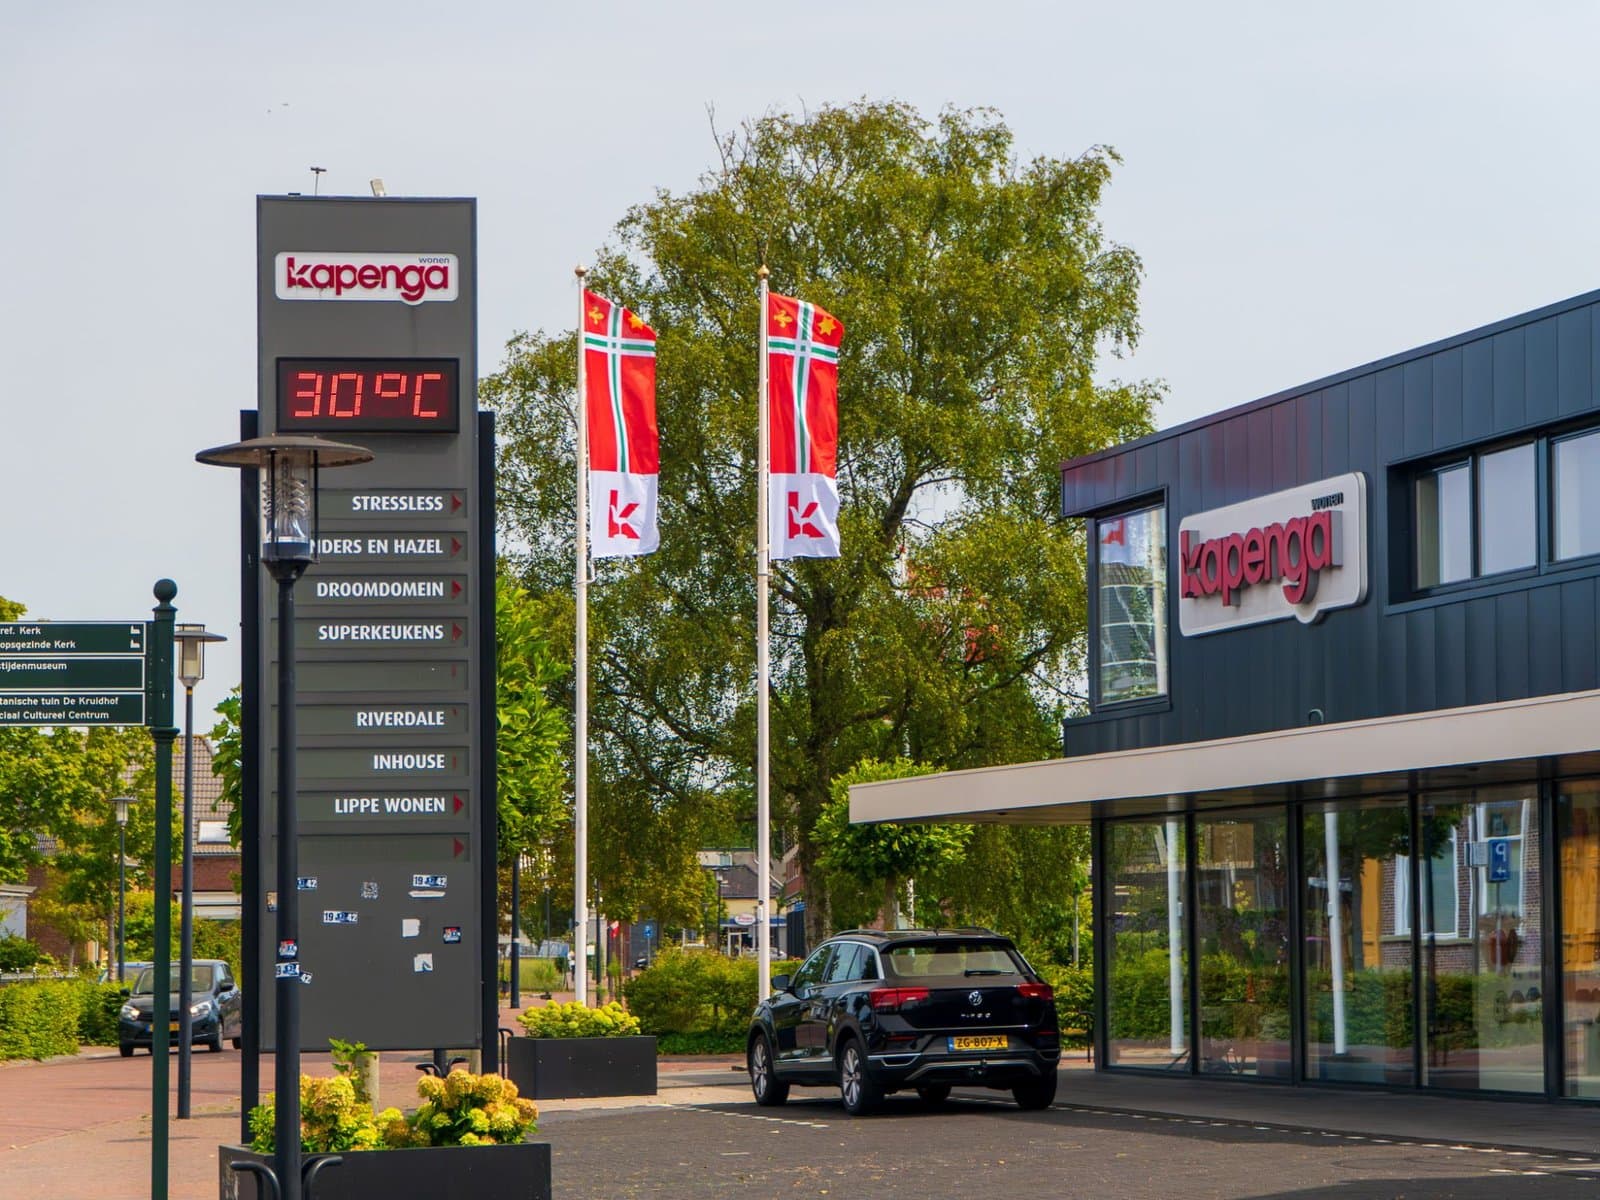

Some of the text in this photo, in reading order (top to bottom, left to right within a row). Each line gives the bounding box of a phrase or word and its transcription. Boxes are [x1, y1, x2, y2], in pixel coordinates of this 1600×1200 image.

[286, 257, 449, 301] kapenga
[352, 496, 444, 511] STRESSLESS
[367, 539, 389, 554] EN
[393, 539, 444, 555] HAZEL
[1180, 510, 1335, 607] kapenga
[316, 582, 444, 598] DROOMDOMEIN
[19, 626, 41, 635] Kerk
[318, 625, 444, 641] SUPERKEUKENS
[54, 640, 76, 649] Kerk
[41, 697, 60, 705] tuin
[63, 697, 76, 705] De
[79, 697, 119, 705] Kruidhof
[23, 711, 67, 720] Cultureel
[69, 711, 110, 720] Centrum
[356, 711, 445, 727] RIVERDALE
[373, 754, 446, 770] INHOUSE
[335, 798, 446, 814] LIPPE WONEN
